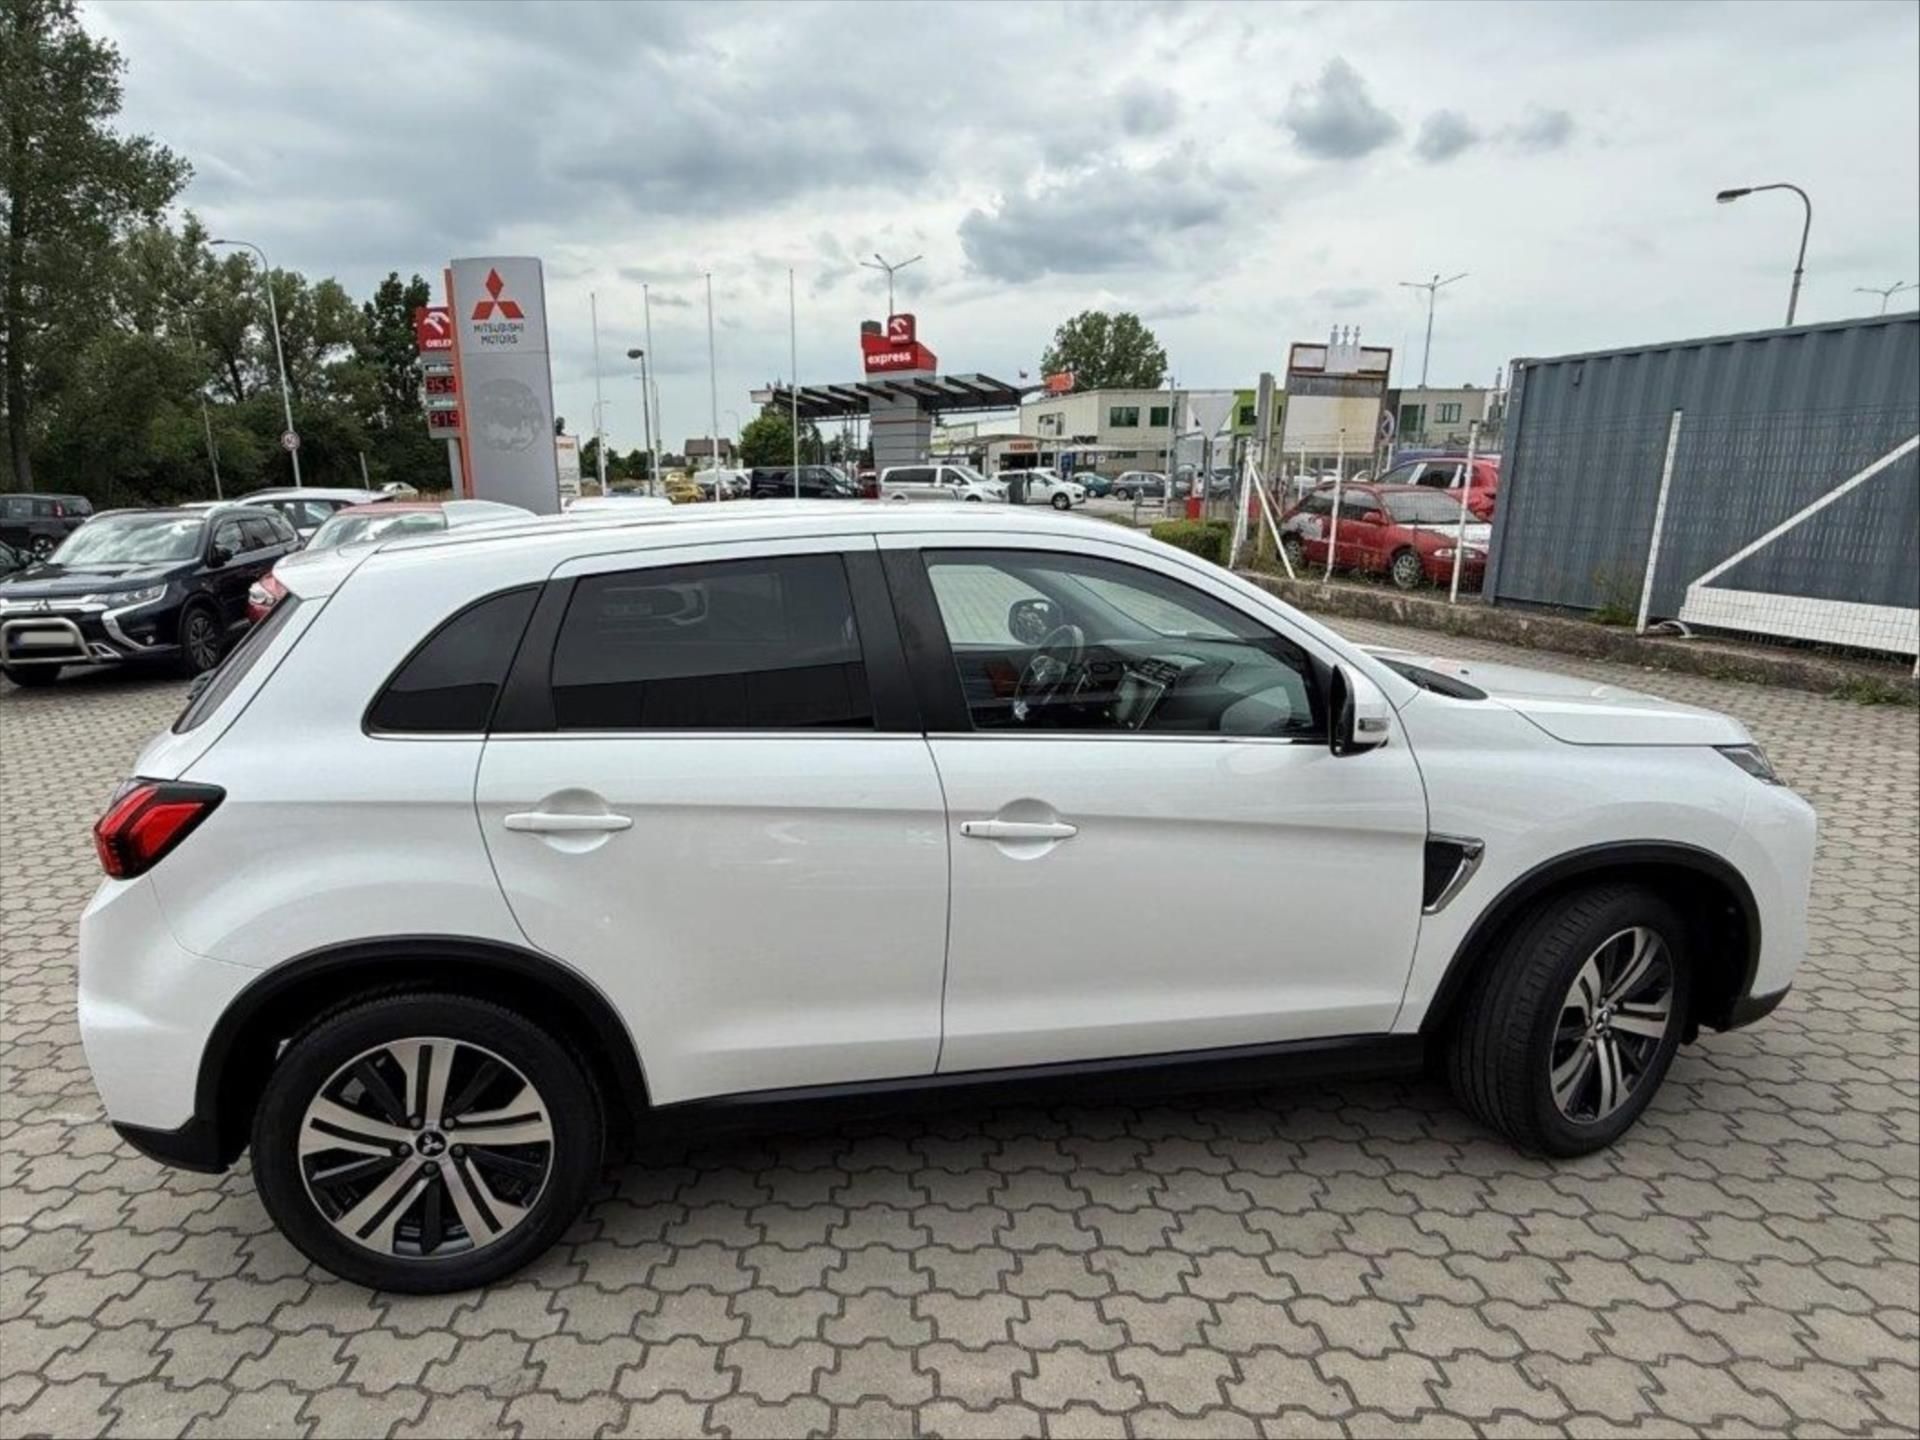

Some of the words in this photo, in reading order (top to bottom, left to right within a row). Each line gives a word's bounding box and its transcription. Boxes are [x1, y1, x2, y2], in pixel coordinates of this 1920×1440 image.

[473, 322, 524, 333] MITSUBISHI
[481, 334, 518, 345] MOTORS
[867, 351, 912, 365] express
